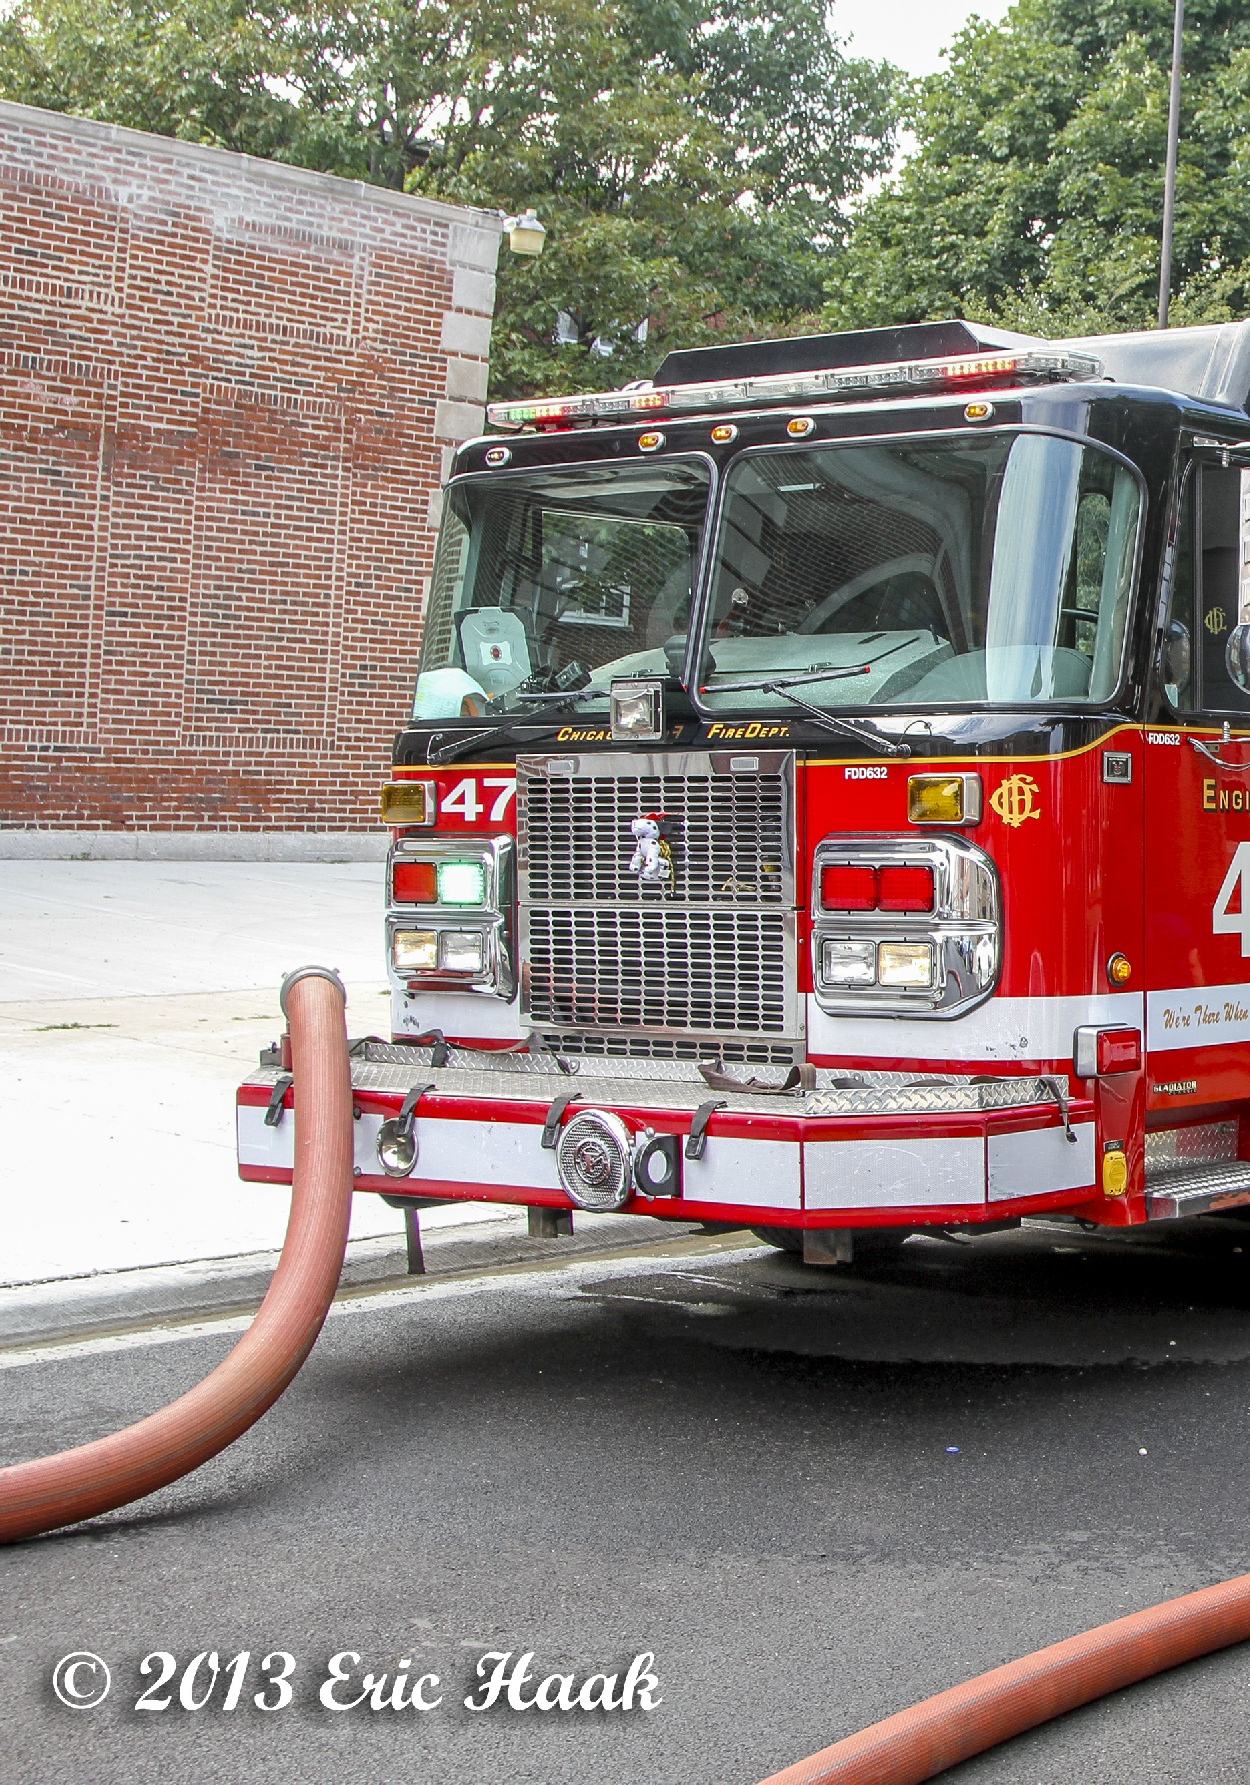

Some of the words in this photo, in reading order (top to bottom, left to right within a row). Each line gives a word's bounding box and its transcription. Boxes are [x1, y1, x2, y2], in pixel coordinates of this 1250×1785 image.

[1148, 732, 1181, 746] FDD632
[844, 767, 888, 779] FDD632
[440, 777, 517, 822] 47
[1163, 1007, 1191, 1029] We're
[1194, 1004, 1220, 1027] There
[1223, 1001, 1248, 1022] When
[1153, 1080, 1197, 1093] GLADIATOR
